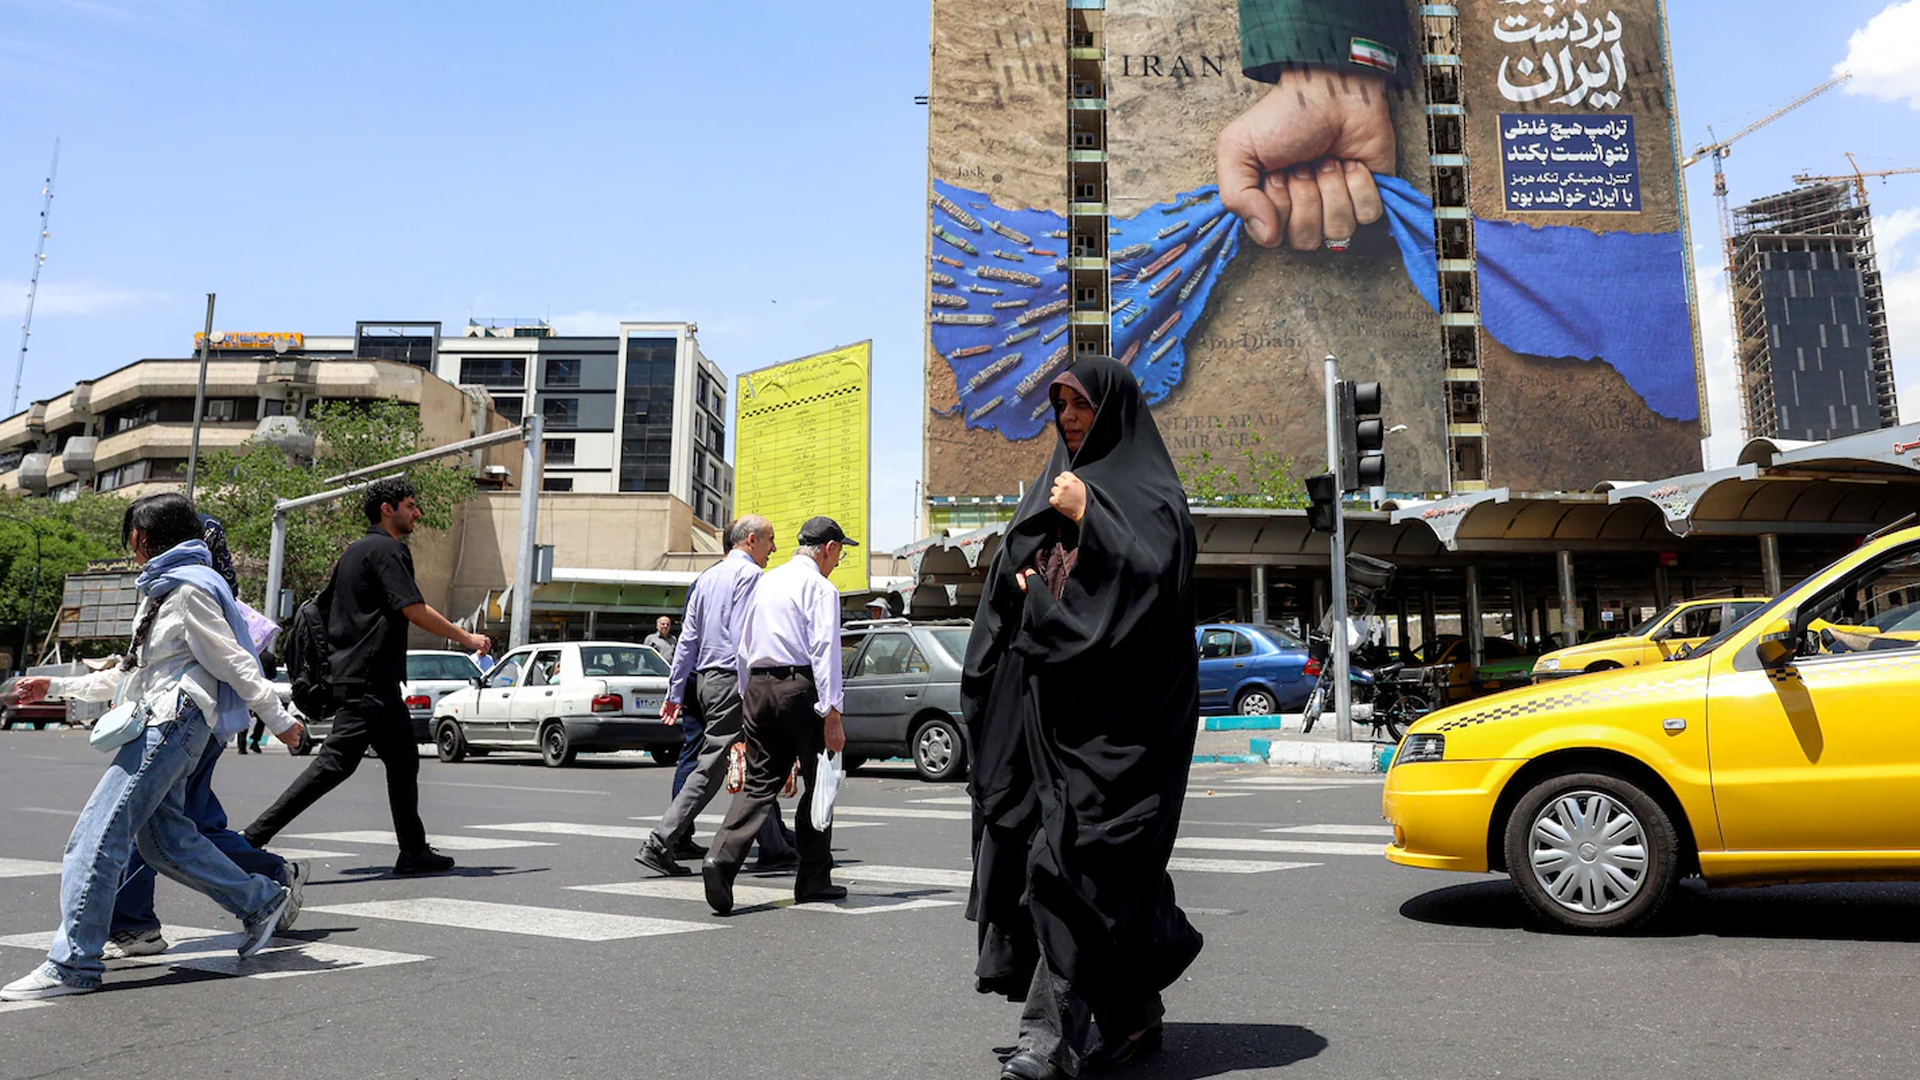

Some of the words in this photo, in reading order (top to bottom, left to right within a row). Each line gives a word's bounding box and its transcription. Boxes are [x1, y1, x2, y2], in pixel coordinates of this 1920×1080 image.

[1122, 55, 1224, 77] IRAN
[1497, 40, 1627, 109] ایران
[1504, 118, 1548, 140] غلطی
[1549, 122, 1583, 142] هیچ
[1584, 119, 1628, 142] ترامپ
[1507, 143, 1549, 166] بکند
[1550, 142, 1630, 168] نتوانست
[955, 165, 986, 180] Jask
[1510, 173, 1535, 186] هرمز
[1536, 172, 1559, 183] تنگه
[1560, 172, 1605, 186] همیشگی
[1604, 172, 1633, 186] کنترل
[1510, 190, 1534, 208] بود
[1535, 187, 1587, 208] خواهد
[1588, 187, 1619, 208] ایران
[1622, 188, 1633, 208] با
[1241, 328, 1301, 353] Dhabi
[1519, 374, 1560, 387] Dubai
[1158, 415, 1220, 430] NITED
[1227, 413, 1279, 428] ARAB
[1588, 413, 1661, 430] Muscat
